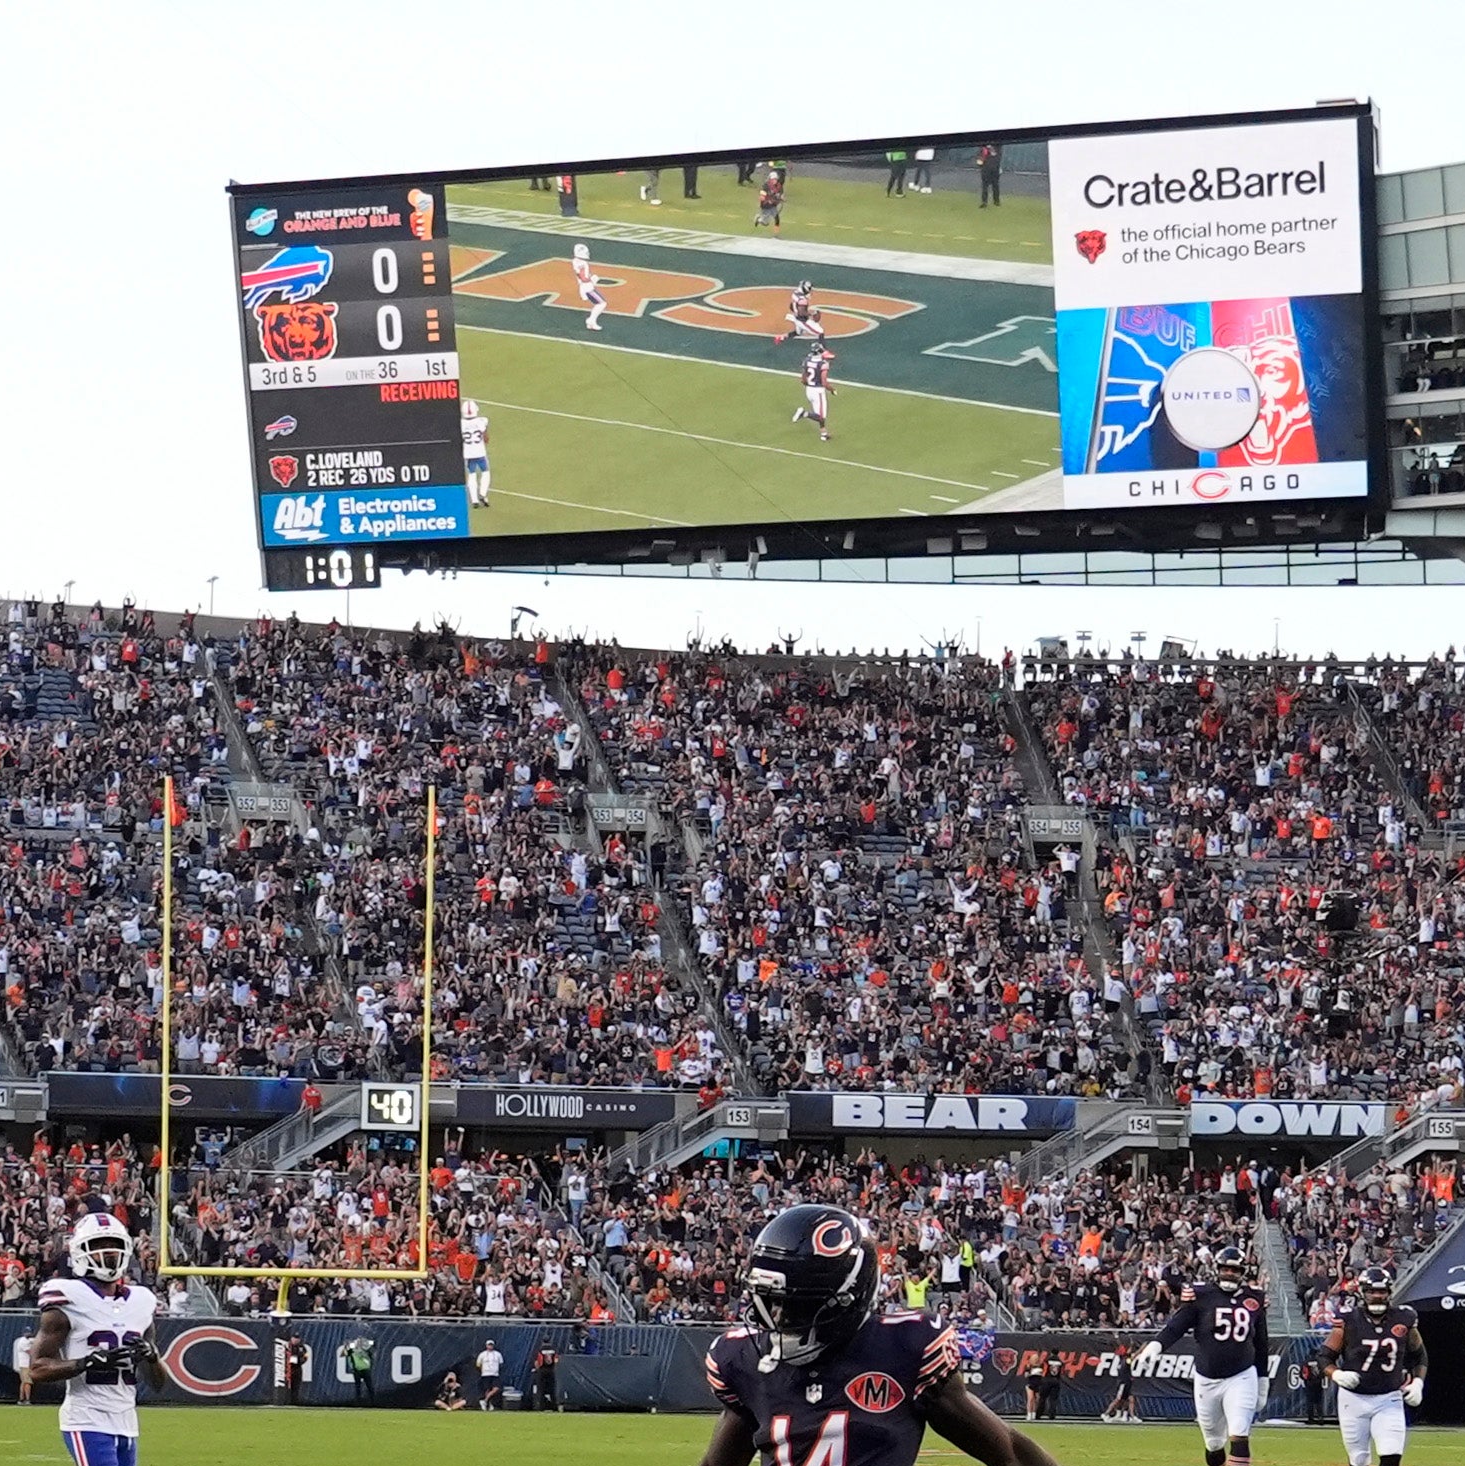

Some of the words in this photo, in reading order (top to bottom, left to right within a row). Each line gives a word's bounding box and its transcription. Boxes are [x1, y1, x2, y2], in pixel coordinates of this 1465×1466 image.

[1083, 160, 1326, 209] Crate&Barrel
[284, 216, 338, 233] ORANGE
[340, 215, 368, 229] AND
[370, 212, 402, 228] BLUE
[294, 211, 312, 220] THE
[313, 209, 332, 219] NEW
[358, 207, 370, 216] OF
[370, 206, 388, 216] THE
[1121, 226, 1148, 243] the
[1154, 221, 1212, 242] official
[1217, 219, 1267, 238] home
[1271, 215, 1338, 237] partner
[1122, 248, 1141, 264] of
[1143, 246, 1171, 263] the
[1175, 242, 1250, 262] Chicago
[1254, 239, 1306, 256] Bears
[372, 248, 399, 294] 0
[376, 304, 404, 350] 0
[262, 366, 288, 386] 3rd
[292, 366, 304, 384] &
[308, 366, 316, 382] 5
[378, 361, 398, 379] 36
[425, 359, 447, 377] 1st
[380, 381, 458, 402] RECEIVING
[1172, 390, 1232, 400] UNITED
[306, 451, 383, 470] C.LOVELAND
[308, 474, 317, 487] 2
[319, 472, 344, 486] REC
[350, 470, 368, 485] 26
[369, 468, 396, 484] YDS
[401, 466, 410, 482] 0
[412, 465, 430, 481] TD
[273, 494, 326, 530] Abt
[338, 495, 436, 516] Electronics
[340, 519, 355, 535] &
[358, 516, 457, 538] Appliances
[305, 550, 375, 587] 1:01
[369, 1089, 413, 1125] 40
[496, 1094, 584, 1118] HOLLYWOOD
[586, 1103, 636, 1112] CASINO
[728, 1110, 749, 1122] 153
[832, 1095, 1028, 1130] BEAR
[1130, 1119, 1150, 1132] 154
[1190, 1102, 1385, 1136] DOWN
[1431, 1120, 1452, 1134] 155
[1214, 1306, 1250, 1343] 58
[1360, 1338, 1398, 1373] 73
